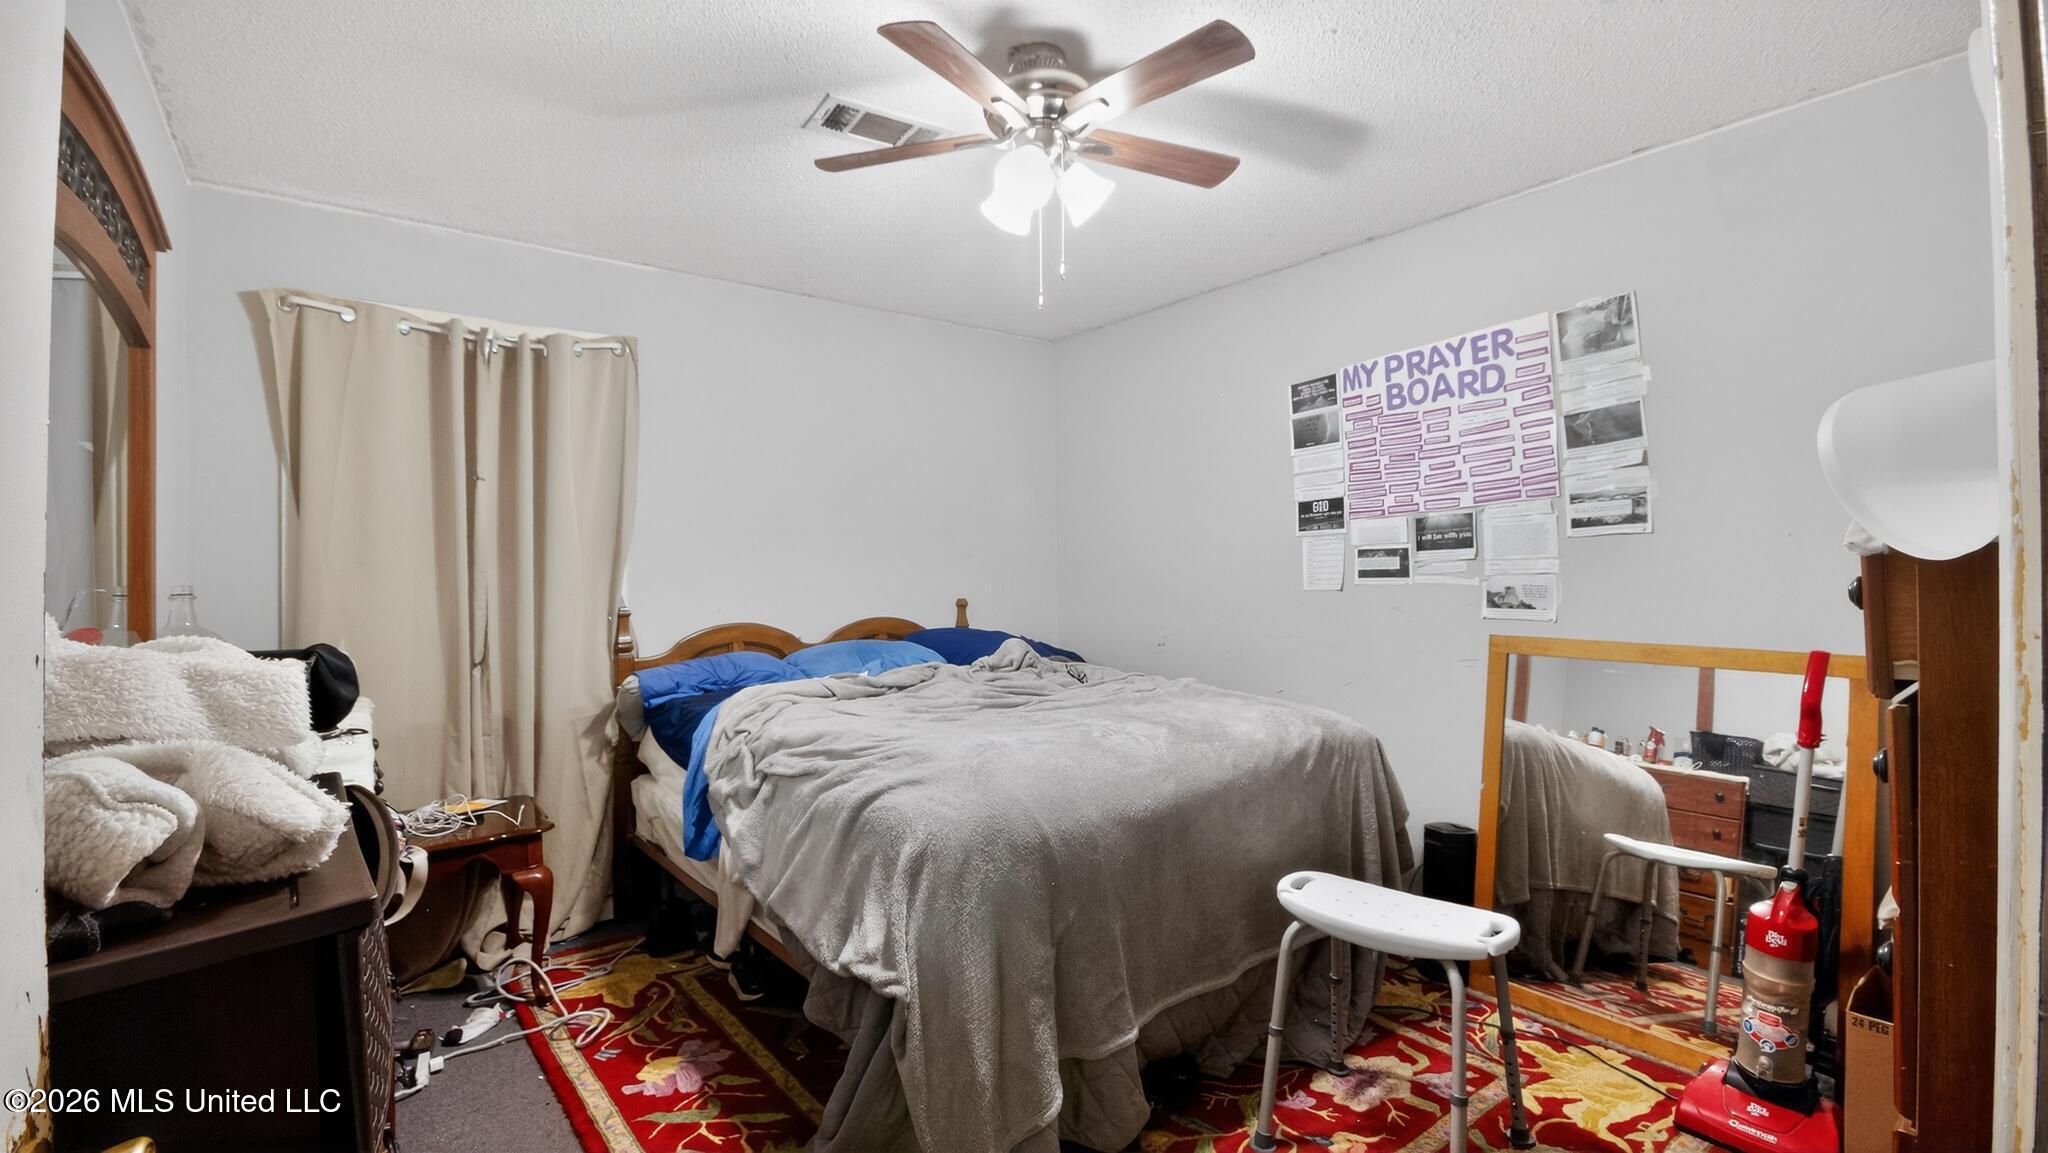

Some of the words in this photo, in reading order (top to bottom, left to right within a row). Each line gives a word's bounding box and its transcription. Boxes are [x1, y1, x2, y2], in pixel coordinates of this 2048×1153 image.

[1343, 360, 1378, 393] MY
[1384, 328, 1515, 382] PRAYER
[1386, 364, 1506, 411] BOARD
